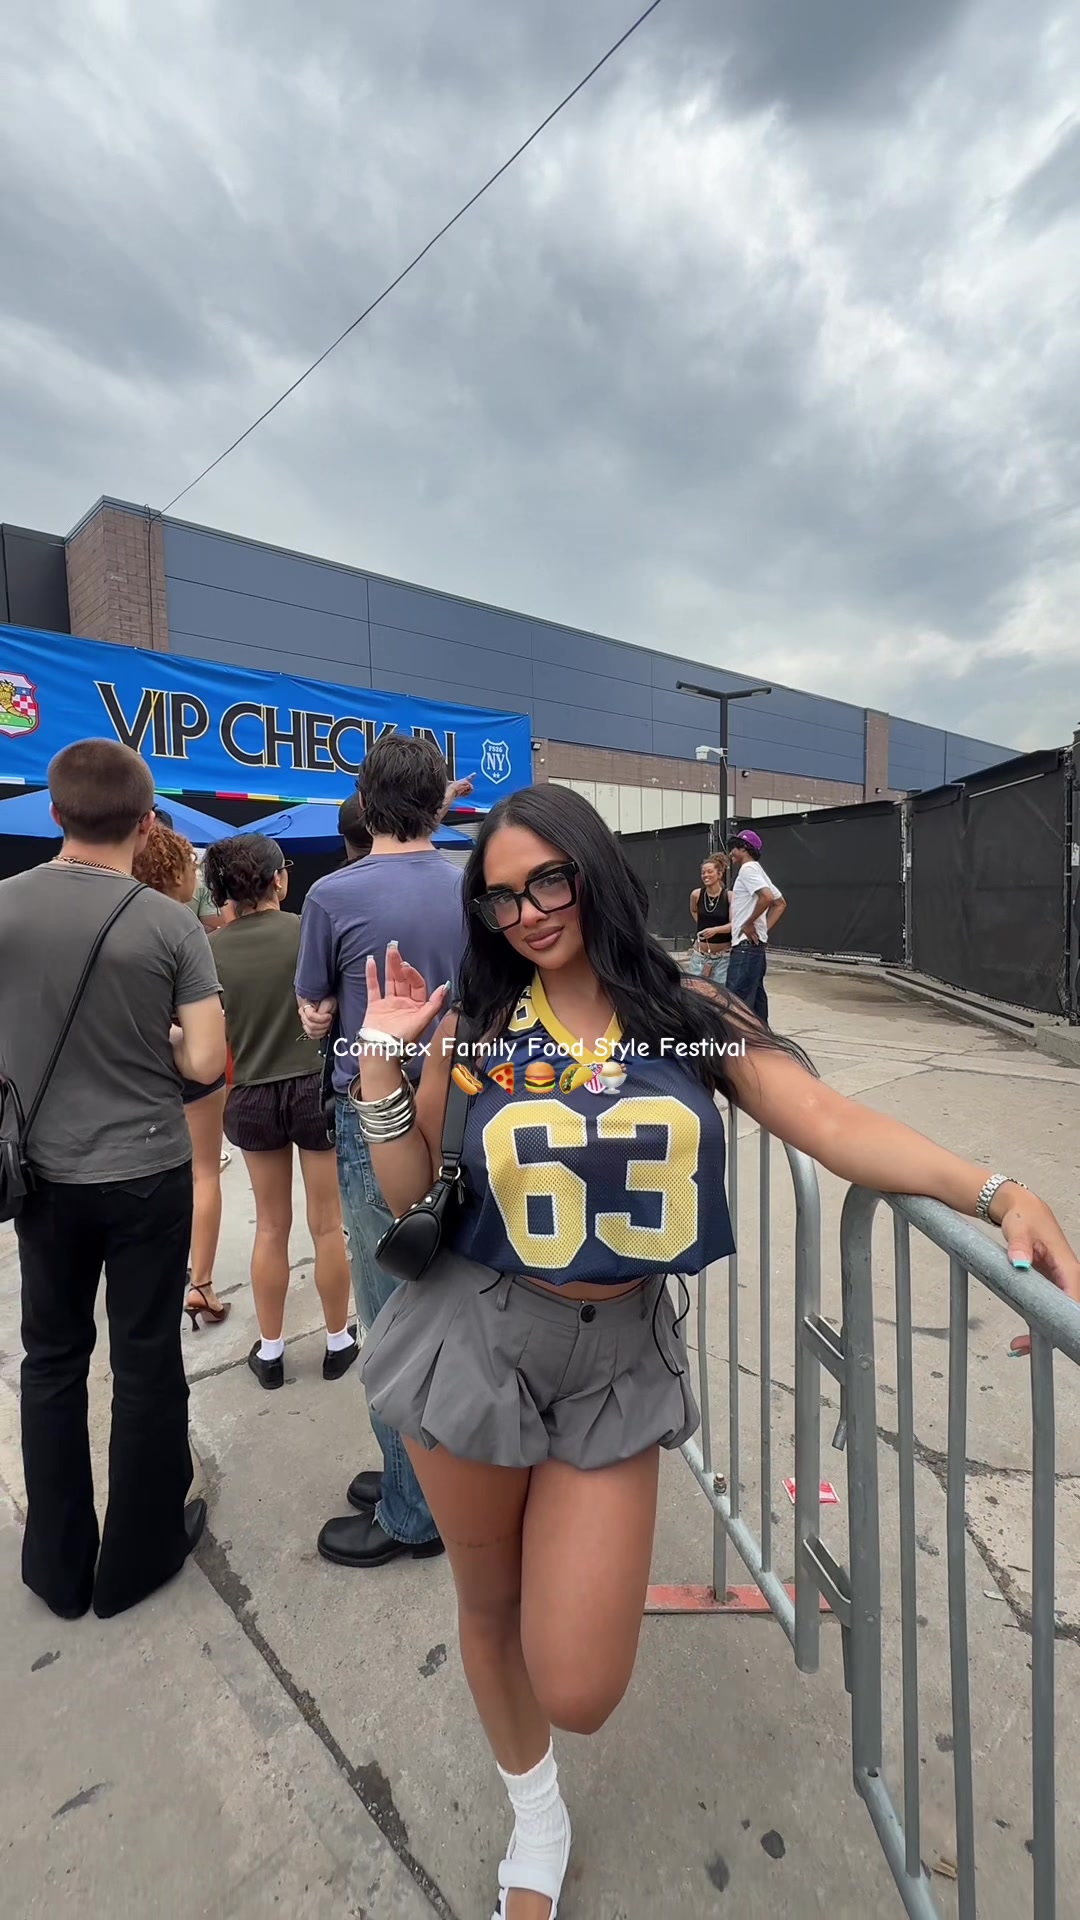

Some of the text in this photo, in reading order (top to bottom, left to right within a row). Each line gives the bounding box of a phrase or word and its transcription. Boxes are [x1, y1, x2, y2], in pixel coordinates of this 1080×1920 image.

[93, 680, 210, 759] VIP
[410, 725, 456, 782] N
[486, 752, 505, 771] NY
[482, 1096, 701, 1269] 63
